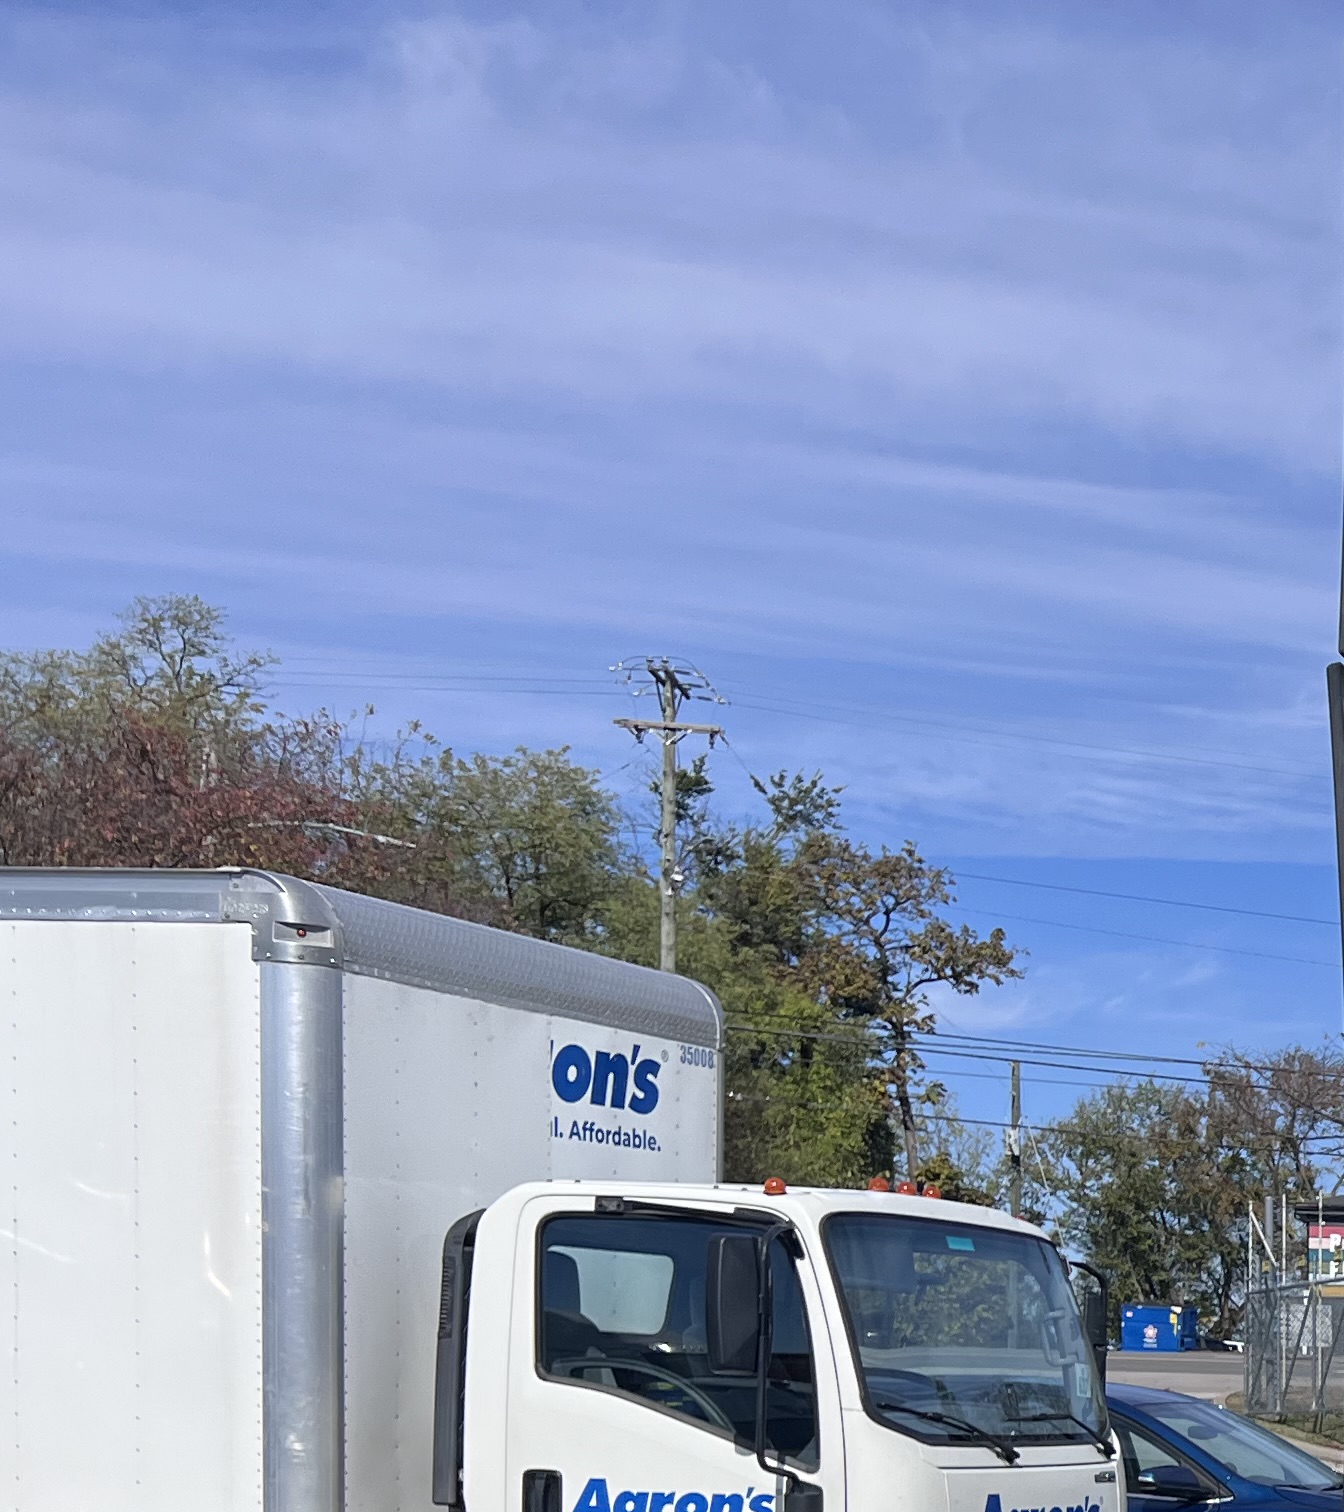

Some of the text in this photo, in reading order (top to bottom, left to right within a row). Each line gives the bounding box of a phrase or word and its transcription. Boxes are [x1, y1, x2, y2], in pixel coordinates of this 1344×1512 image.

[680, 1044, 714, 1069] 35008
[550, 1040, 662, 1115] on's
[568, 1119, 661, 1152] Affordable.
